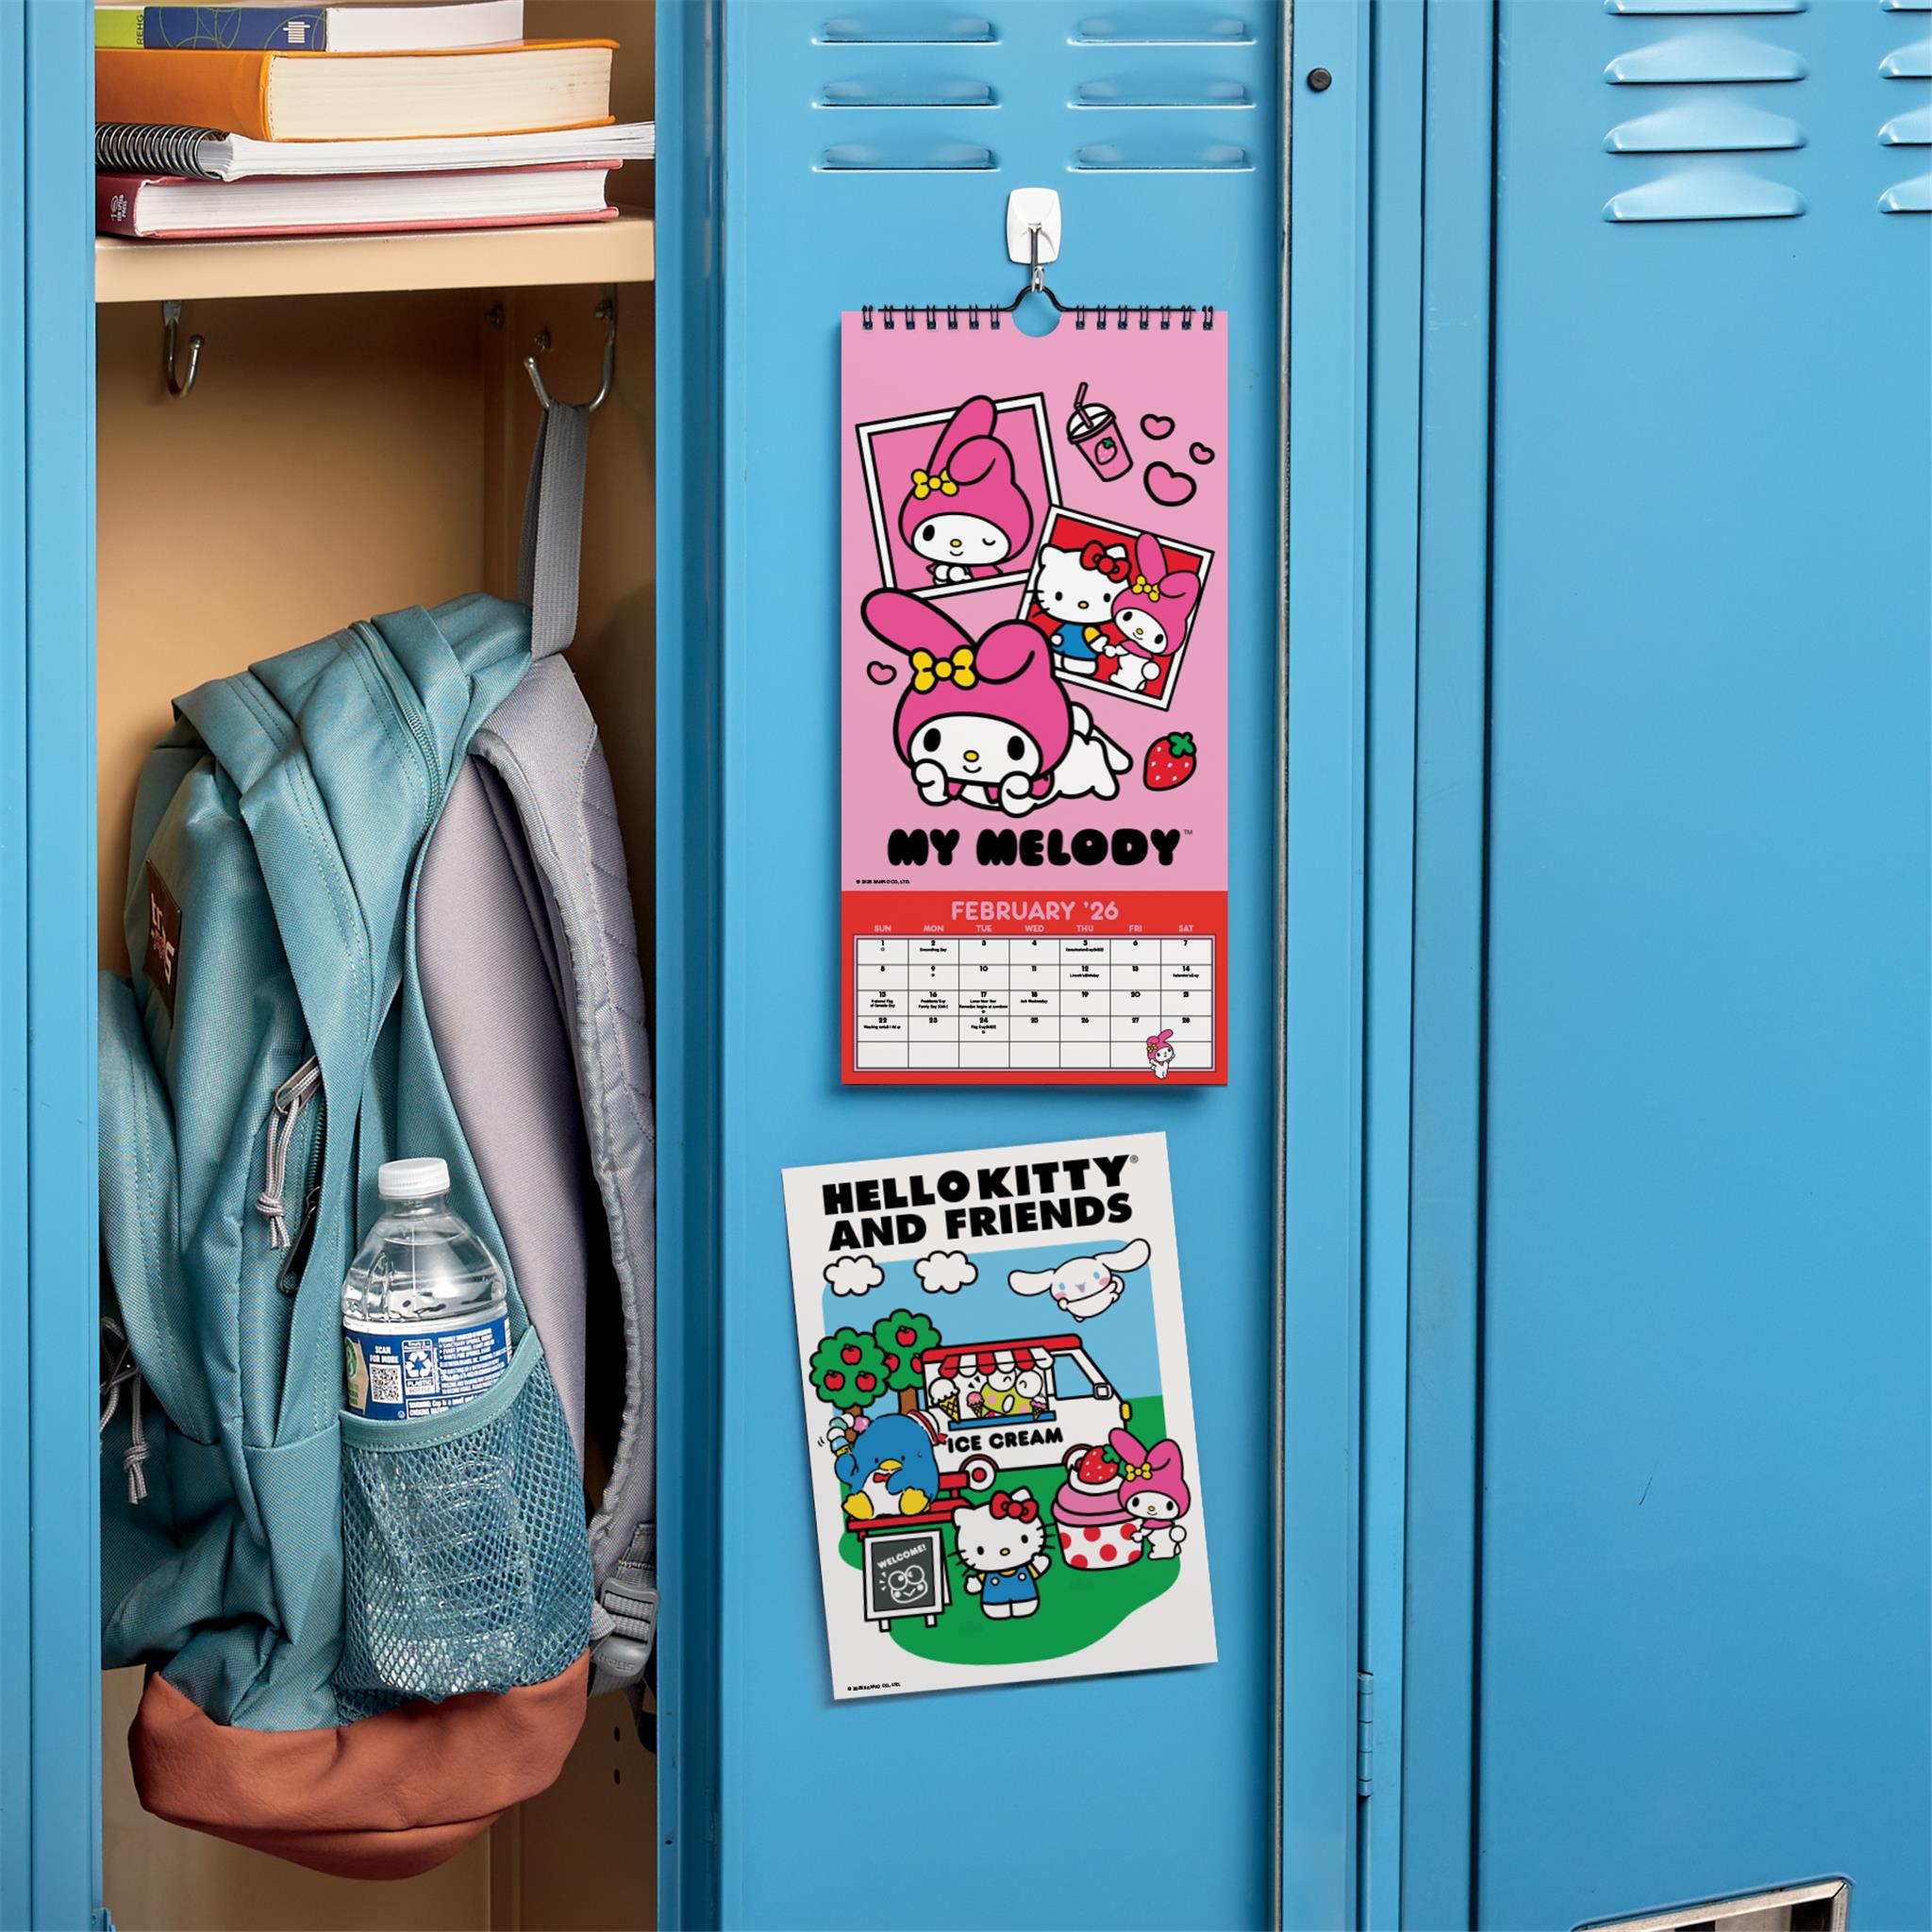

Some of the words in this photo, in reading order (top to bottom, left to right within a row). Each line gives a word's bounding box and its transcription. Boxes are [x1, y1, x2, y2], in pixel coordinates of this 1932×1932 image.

[888, 828, 959, 866] MY
[951, 900, 1076, 921] FEBRUARY
[874, 924, 892, 933] SUN
[923, 924, 944, 933] MON
[974, 924, 992, 933] TUE
[1024, 924, 1045, 933] WED
[1076, 924, 1094, 933] THU
[1129, 924, 1142, 933] FRI
[1178, 924, 1194, 933] SAT
[822, 1170, 971, 1216] HELLO
[828, 1213, 927, 1252] AND
[944, 1192, 1133, 1240] FRIENDS
[370, 1355, 380, 1363] FOR
[381, 1355, 399, 1364] MORE
[375, 1345, 391, 1354] SCAN
[407, 1379, 432, 1388] PLASTIC
[947, 1435, 982, 1454] ICE
[989, 1427, 1064, 1450] CREAM
[876, 1543, 927, 1570] WELCOME!
